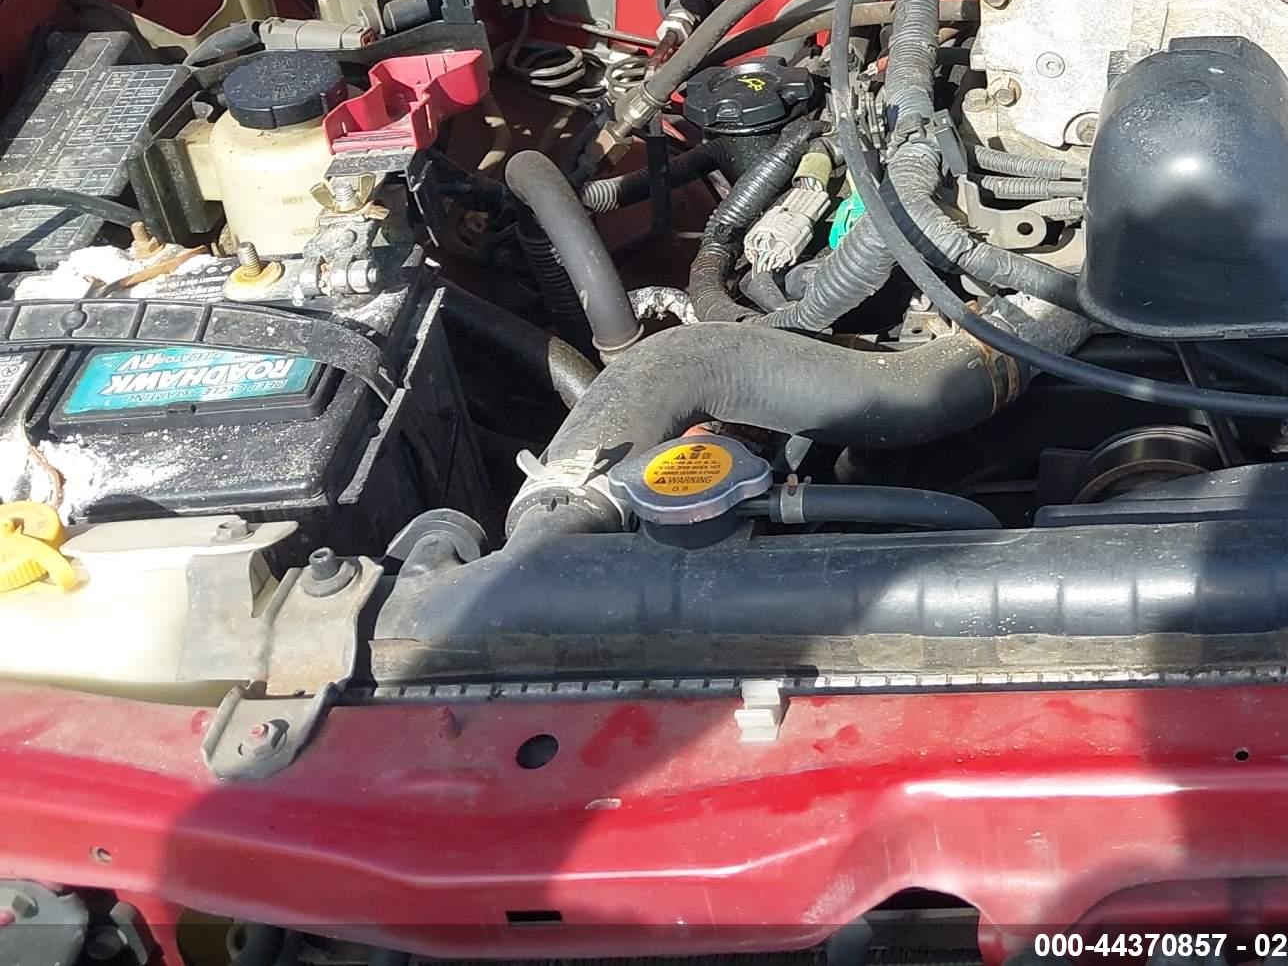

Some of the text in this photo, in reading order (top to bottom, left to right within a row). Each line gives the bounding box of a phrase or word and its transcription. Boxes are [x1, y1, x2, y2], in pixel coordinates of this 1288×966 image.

[101, 358, 295, 395] ROADHAWK
[245, 379, 289, 394] DEEP
[668, 475, 713, 484] WARNING
